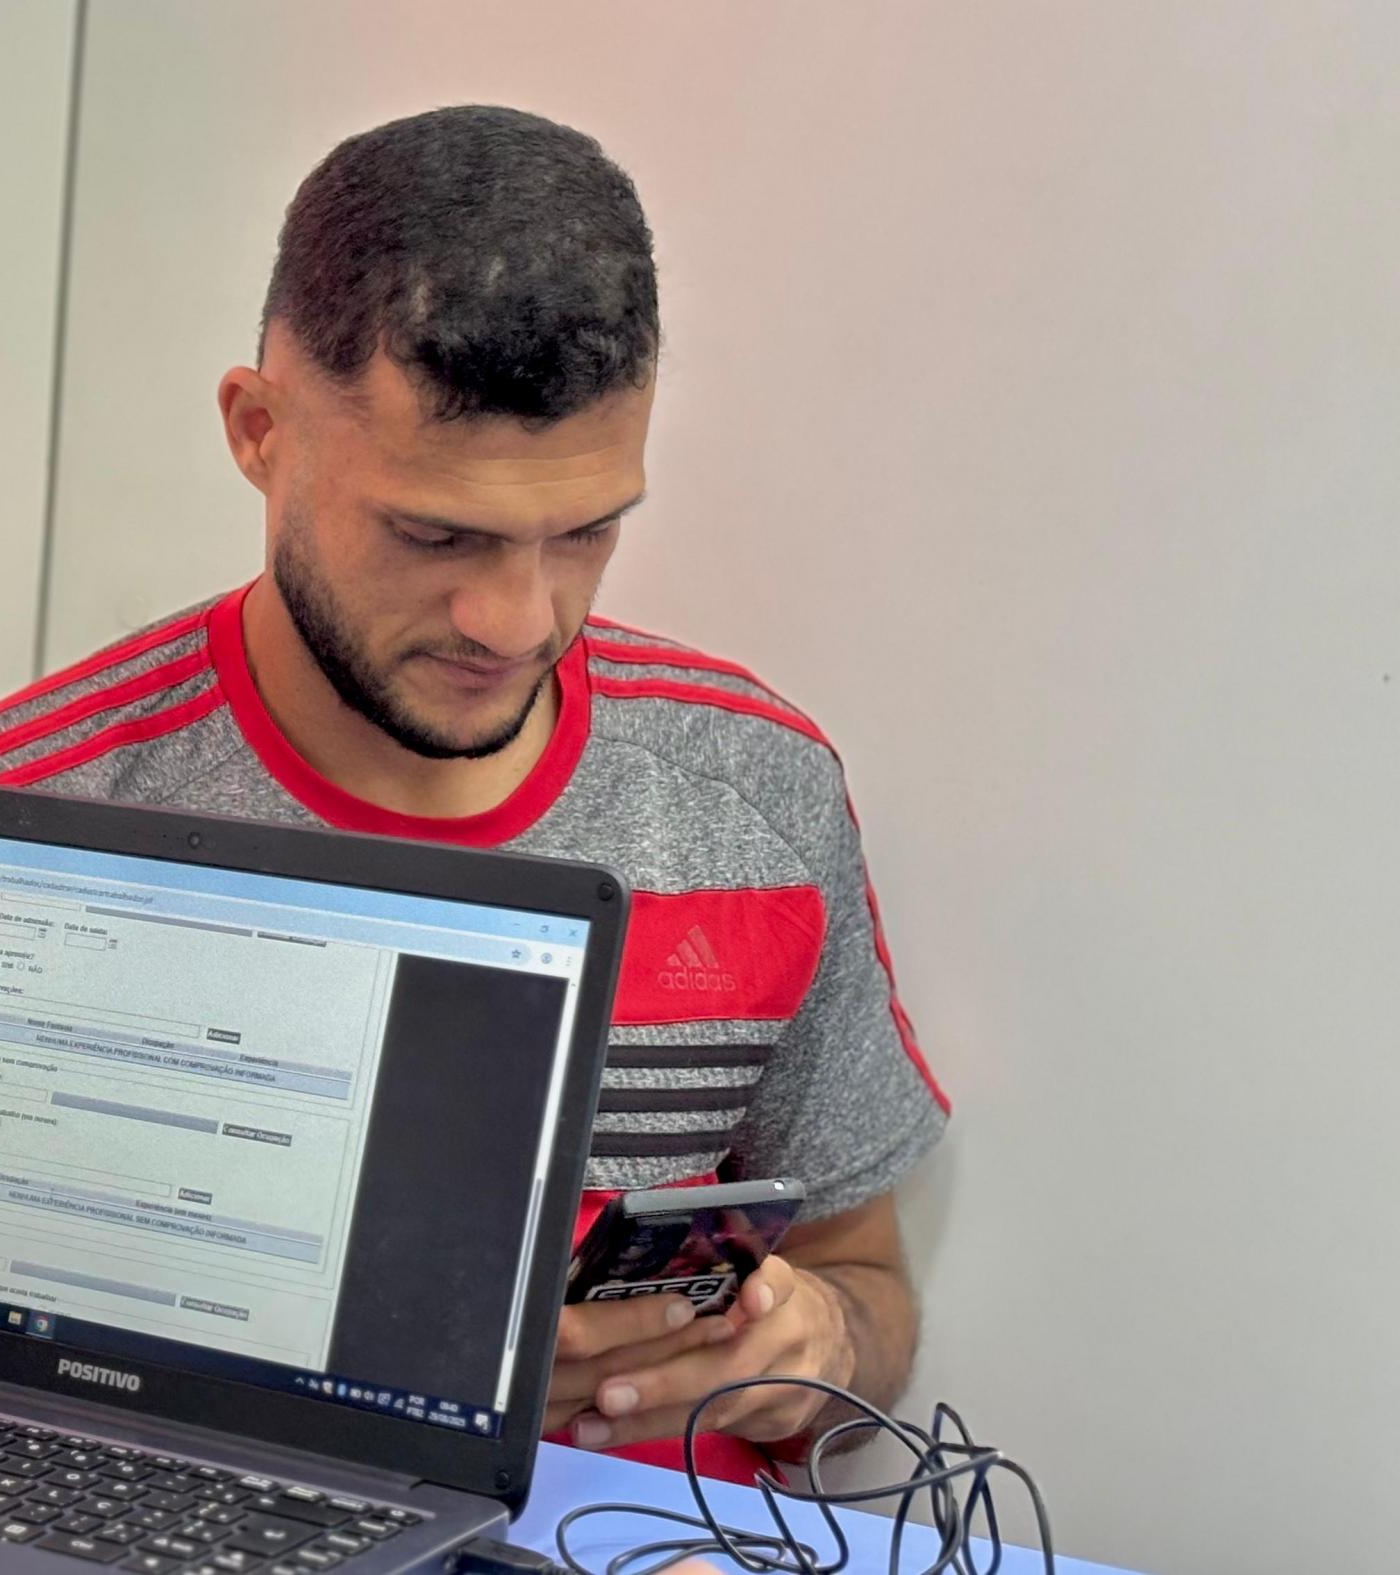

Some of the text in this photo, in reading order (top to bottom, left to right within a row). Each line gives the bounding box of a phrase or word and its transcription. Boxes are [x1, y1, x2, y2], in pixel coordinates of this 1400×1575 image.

[13, 914, 22, 922] de
[63, 921, 79, 931] Data
[79, 924, 88, 932] de
[27, 963, 43, 974] NÃO
[657, 967, 737, 992] adidas
[26, 1017, 46, 1027] Nome
[15, 1058, 58, 1073] comprovação
[36, 1034, 276, 1082] NENHUMA EXPERIÊNCIA PROFISSIONAL COM COMPROVAÇÃO INFORMADA
[8, 1190, 247, 1244] NENHUMA EXPERIÊNCIA PROFISSIONAL SEM COMPROVAÇÃO INFORMADA
[57, 1358, 141, 1391] POSITIVO
